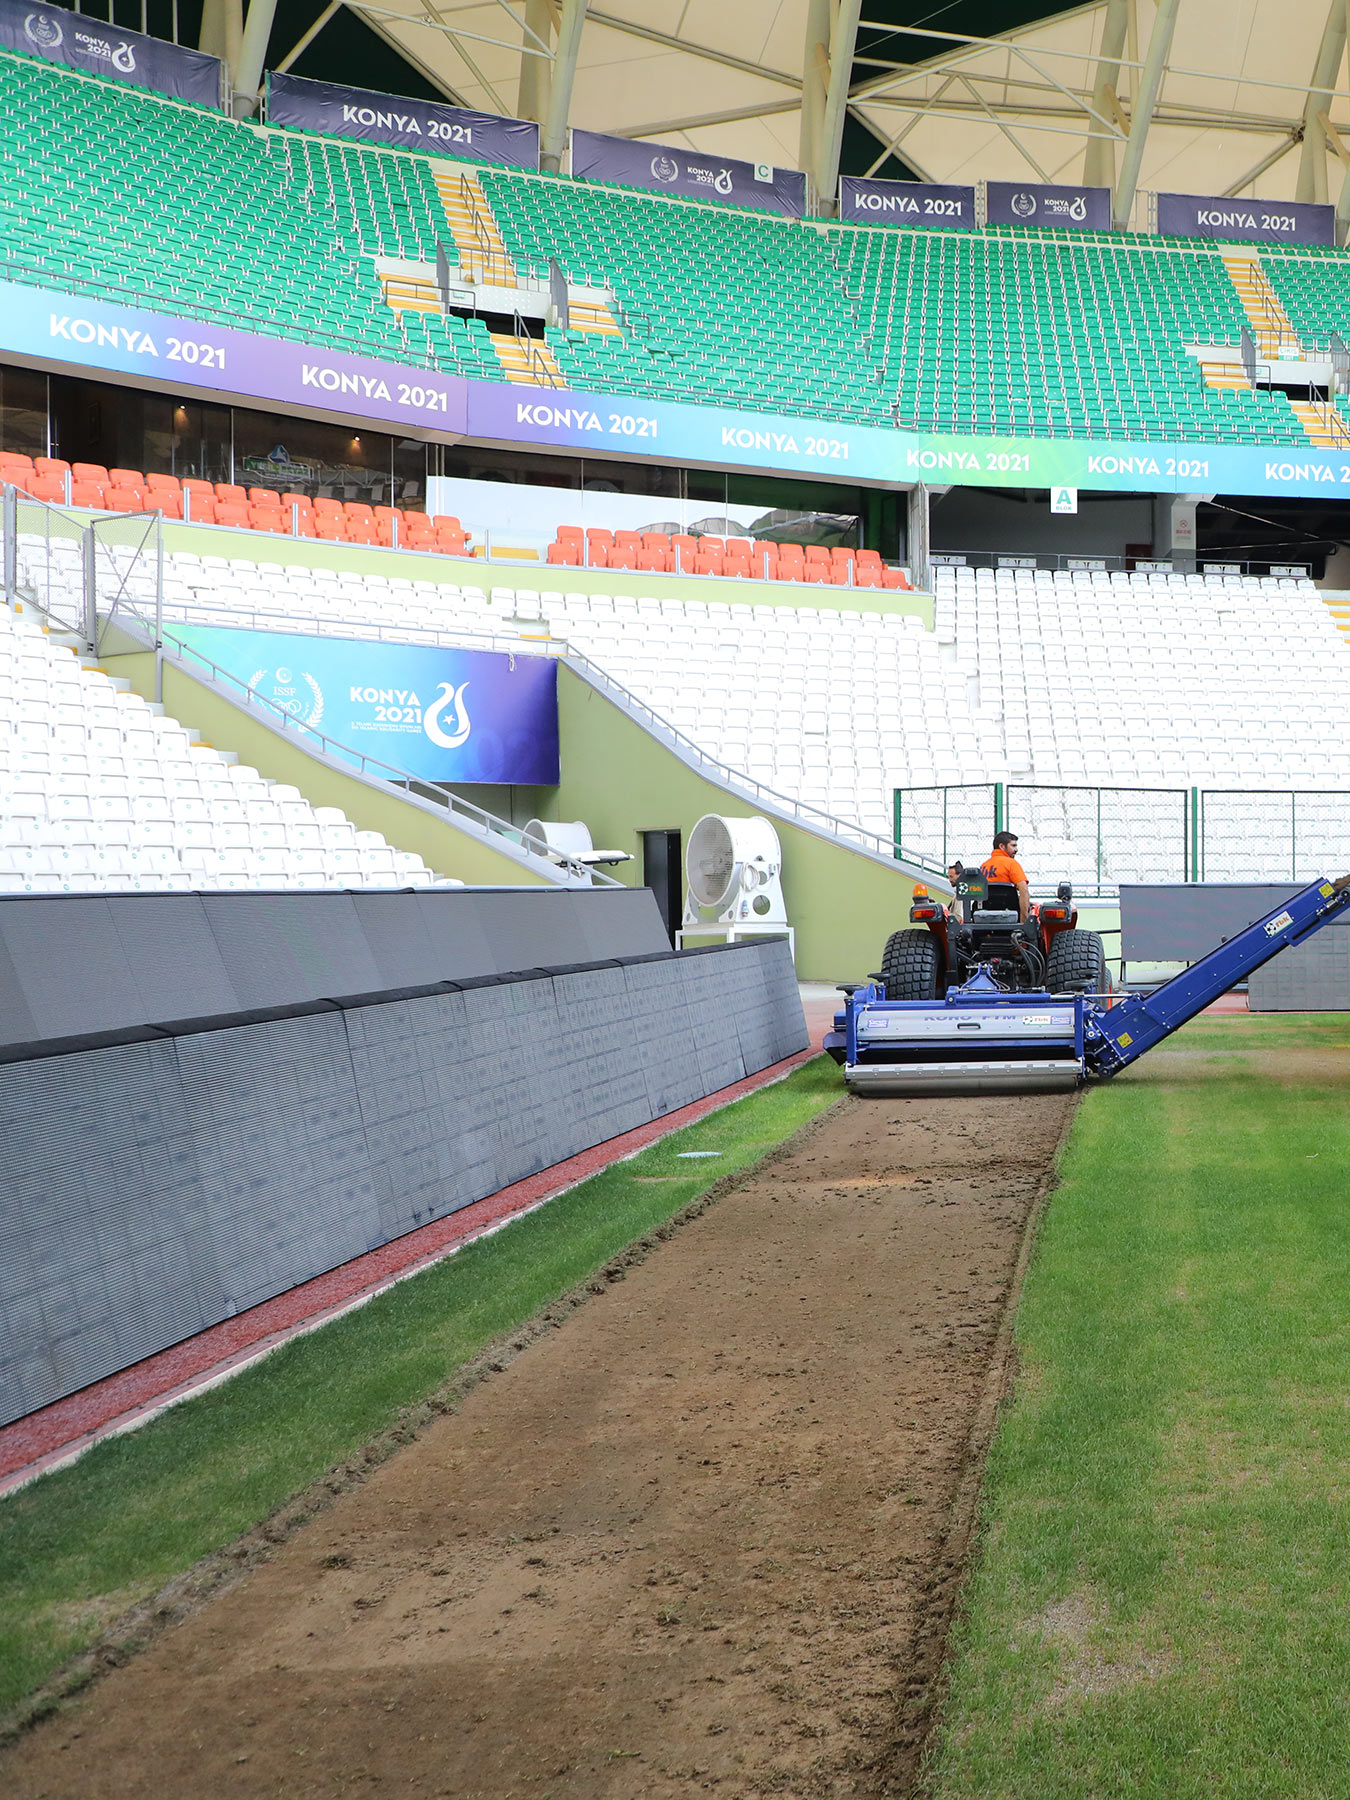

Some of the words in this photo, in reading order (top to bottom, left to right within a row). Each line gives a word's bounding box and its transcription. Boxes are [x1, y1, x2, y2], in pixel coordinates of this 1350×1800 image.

[75, 32, 111, 50] KONYA
[88, 43, 110, 57] 2021
[344, 105, 422, 135] KONYA
[428, 121, 471, 144] 2021
[688, 167, 713, 177] KONYA
[696, 174, 714, 184] 2021
[758, 165, 769, 177] C
[856, 194, 919, 213] KONYA
[925, 200, 961, 215] 2021
[1198, 211, 1257, 228] KONYA
[1262, 216, 1295, 231] 2021
[50, 314, 158, 356] KONYA
[166, 338, 224, 369] 2021
[303, 365, 392, 401] KONYA
[398, 384, 446, 411] 2021
[517, 404, 603, 431] KONYA
[609, 414, 657, 437] 2021
[722, 427, 799, 453] KONYA
[805, 437, 848, 459] 2021
[907, 449, 980, 470] KONYA
[986, 453, 1029, 471] 2021
[1088, 456, 1160, 474] KONYA
[1166, 459, 1208, 477] 2021
[1266, 463, 1335, 482] KONYA
[1056, 489, 1071, 504] A
[273, 686, 296, 697] ISSF
[350, 686, 420, 706] KONYA
[375, 706, 421, 723] 2021
